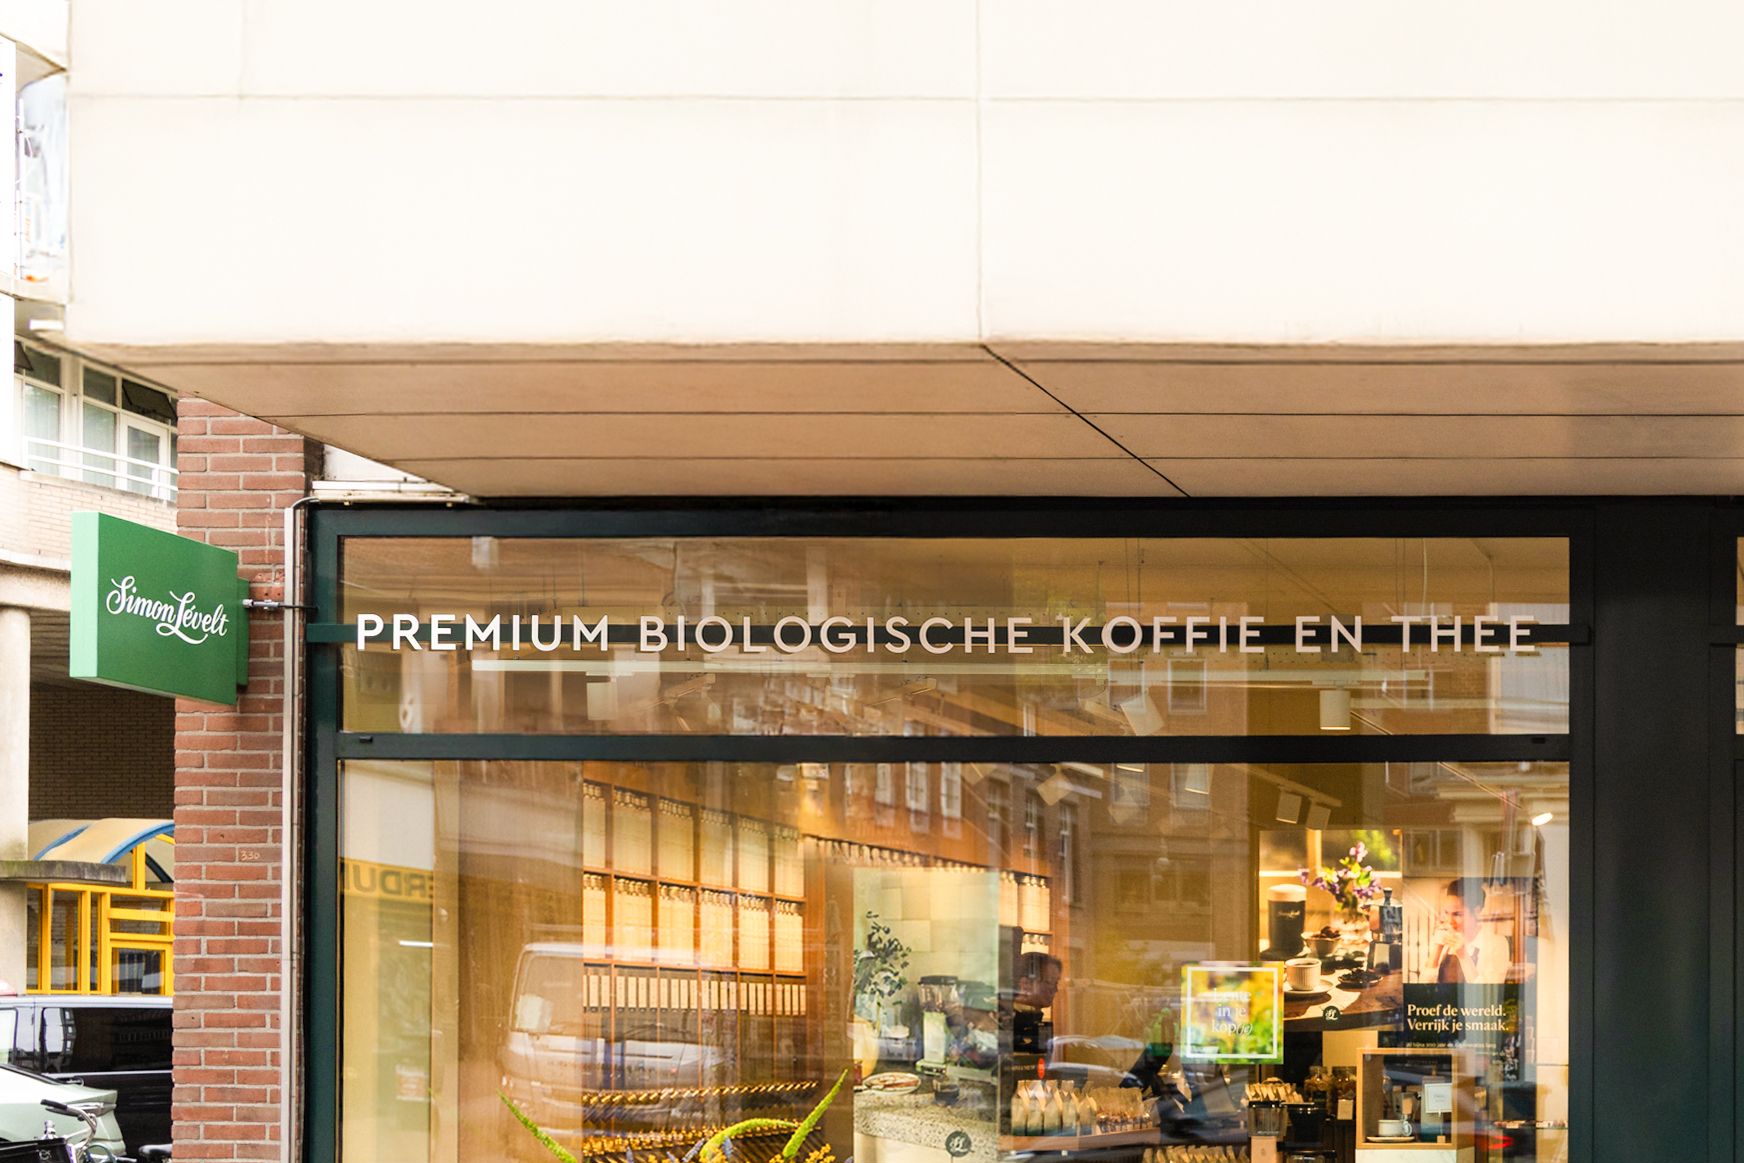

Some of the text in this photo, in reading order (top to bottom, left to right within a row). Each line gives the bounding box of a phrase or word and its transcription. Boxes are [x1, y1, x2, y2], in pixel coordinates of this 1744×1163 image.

[106, 576, 229, 644] Simon Lévelt
[356, 613, 1536, 654] PREMIUM BIOLOGISCHE KOFFIE EN THEE
[1407, 1003, 1507, 1017] Proef de wereld.
[1407, 1018, 1509, 1033] Verrijk je smaak.
